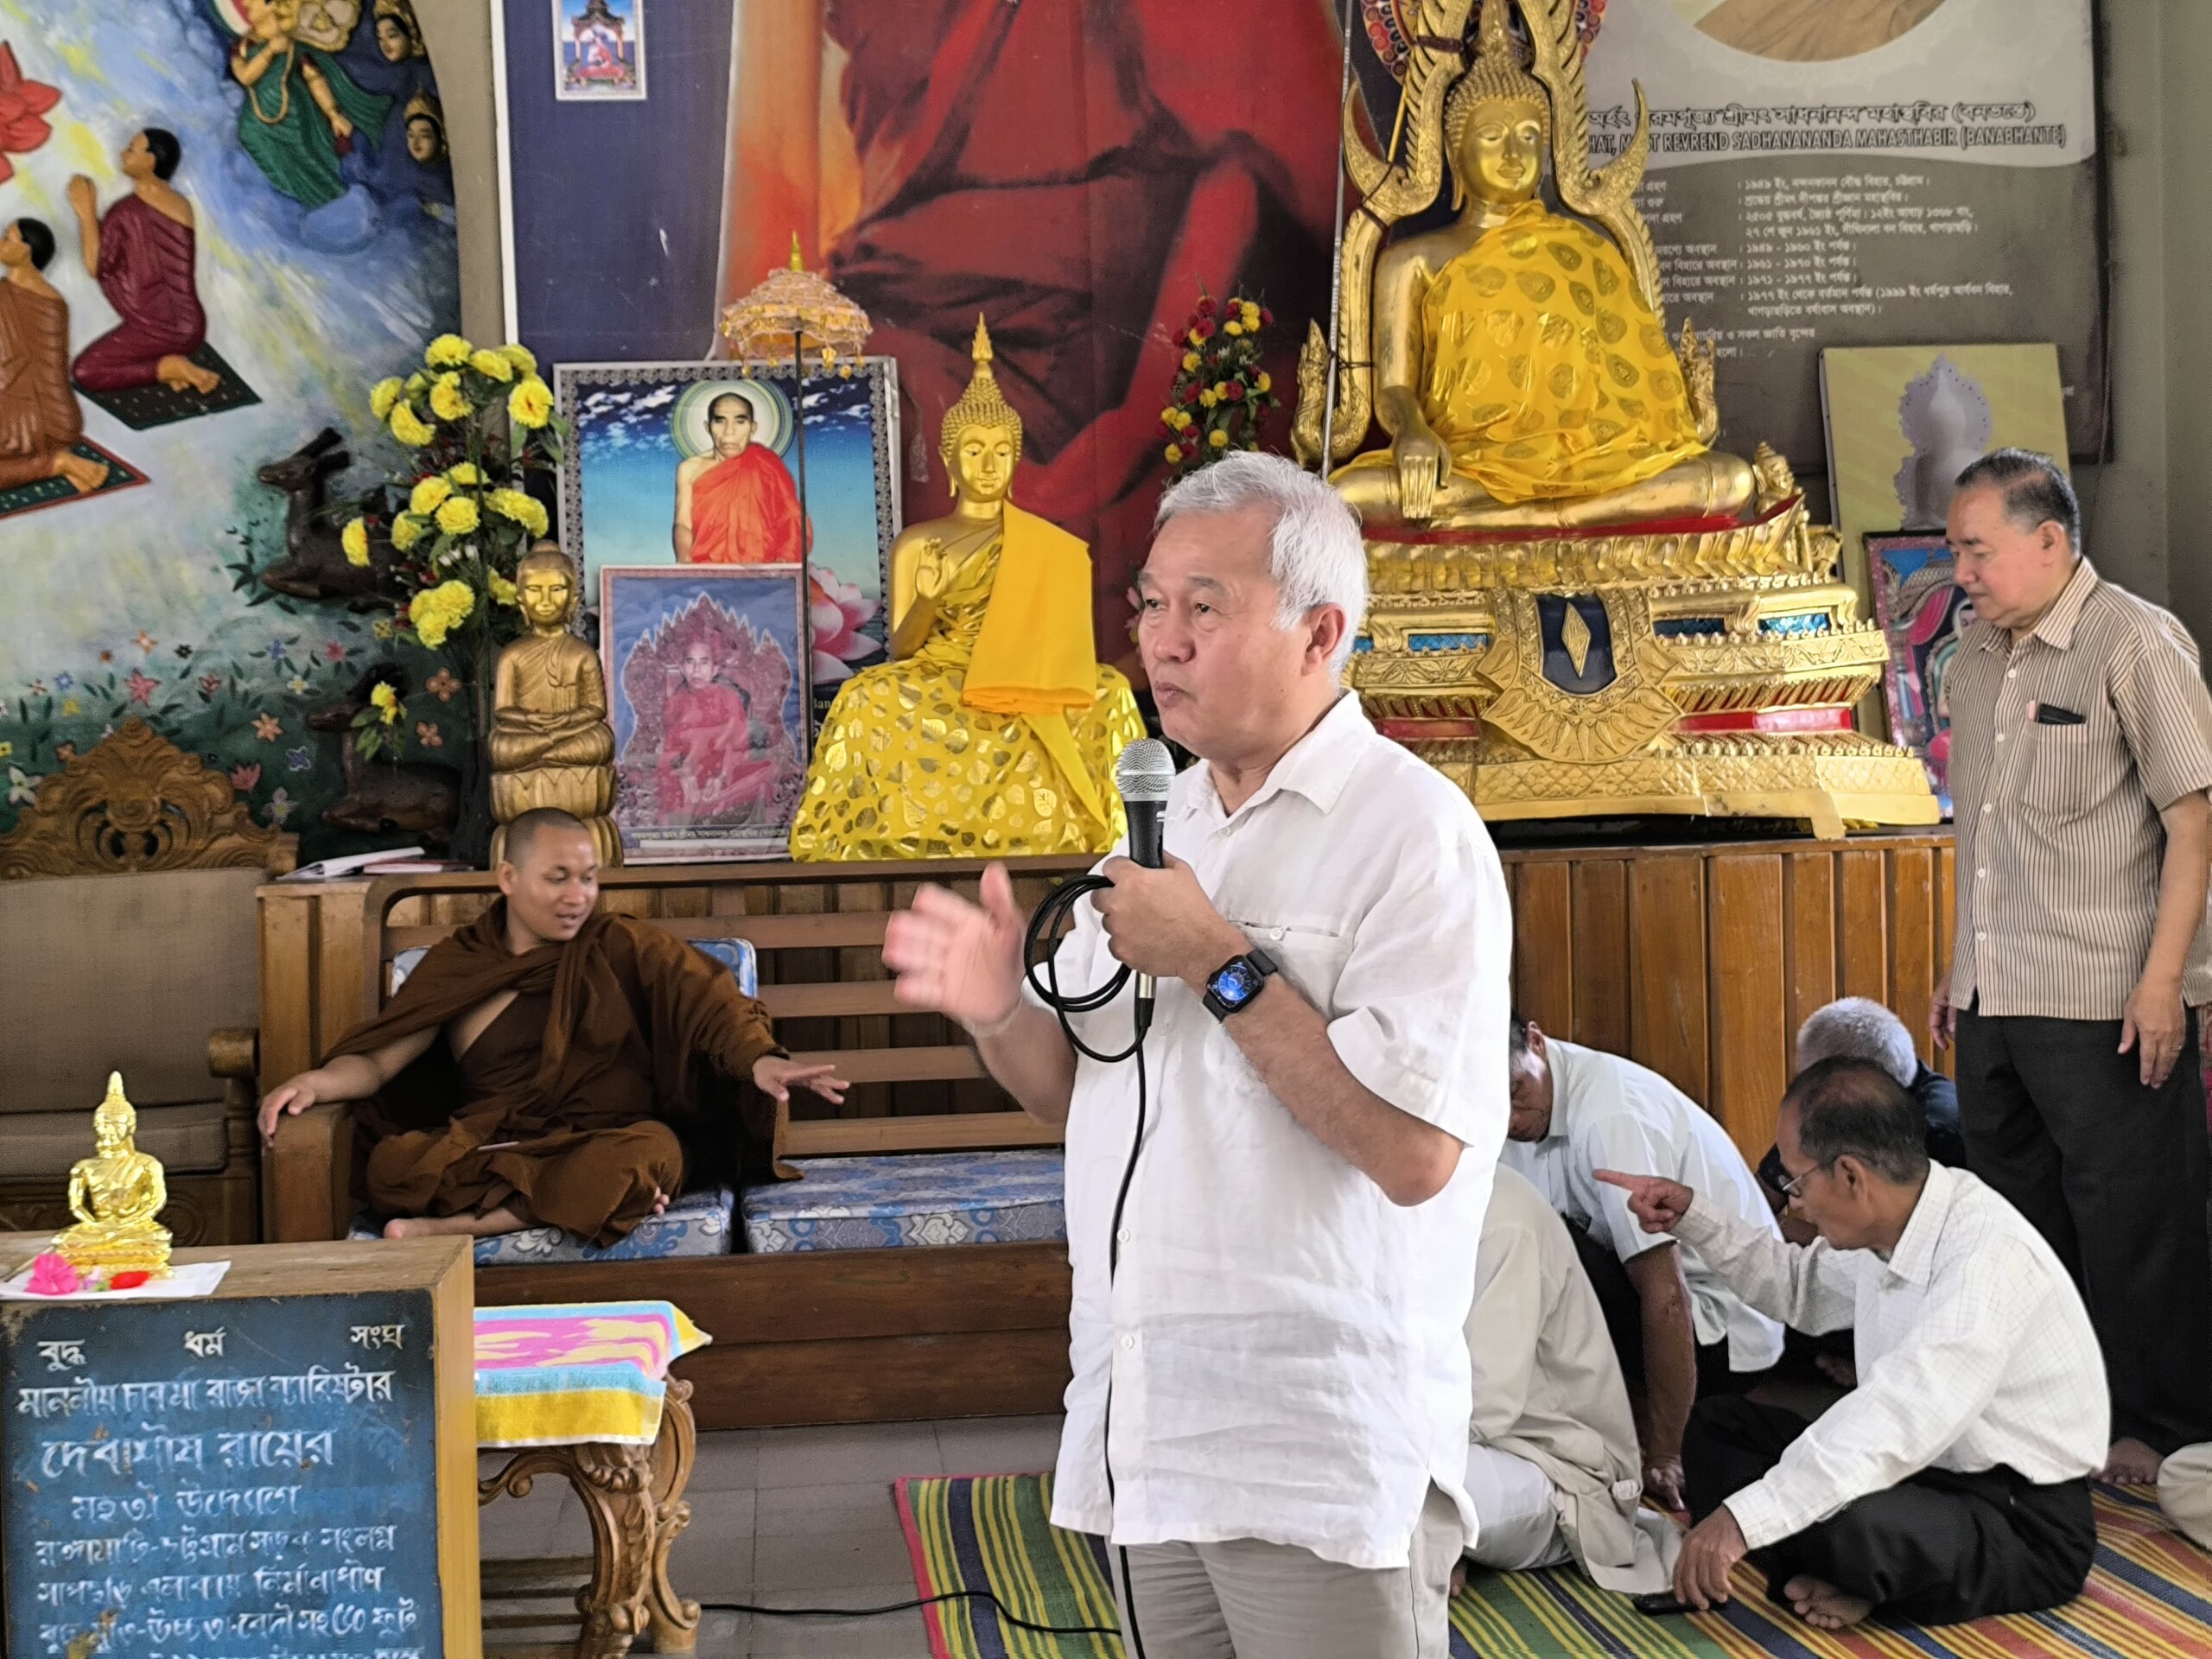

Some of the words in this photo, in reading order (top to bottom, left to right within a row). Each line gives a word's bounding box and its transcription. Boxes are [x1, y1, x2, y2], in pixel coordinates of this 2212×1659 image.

[1662, 132, 1729, 152] REVREND
[1732, 130, 1854, 151] SADHANANANDA
[1855, 127, 1959, 149] MAHASTHABIR
[1960, 124, 2066, 150] (BANABHANTE)
[184, 1326, 226, 1357] ধর্ম
[350, 1324, 405, 1350] সংঘ
[37, 1339, 87, 1371] বুদ্ধ
[17, 1376, 120, 1418] মাননীয়
[206, 1376, 266, 1408] রাজা
[41, 1421, 204, 1478] দেবাশীষ
[218, 1427, 338, 1469] রায়ের
